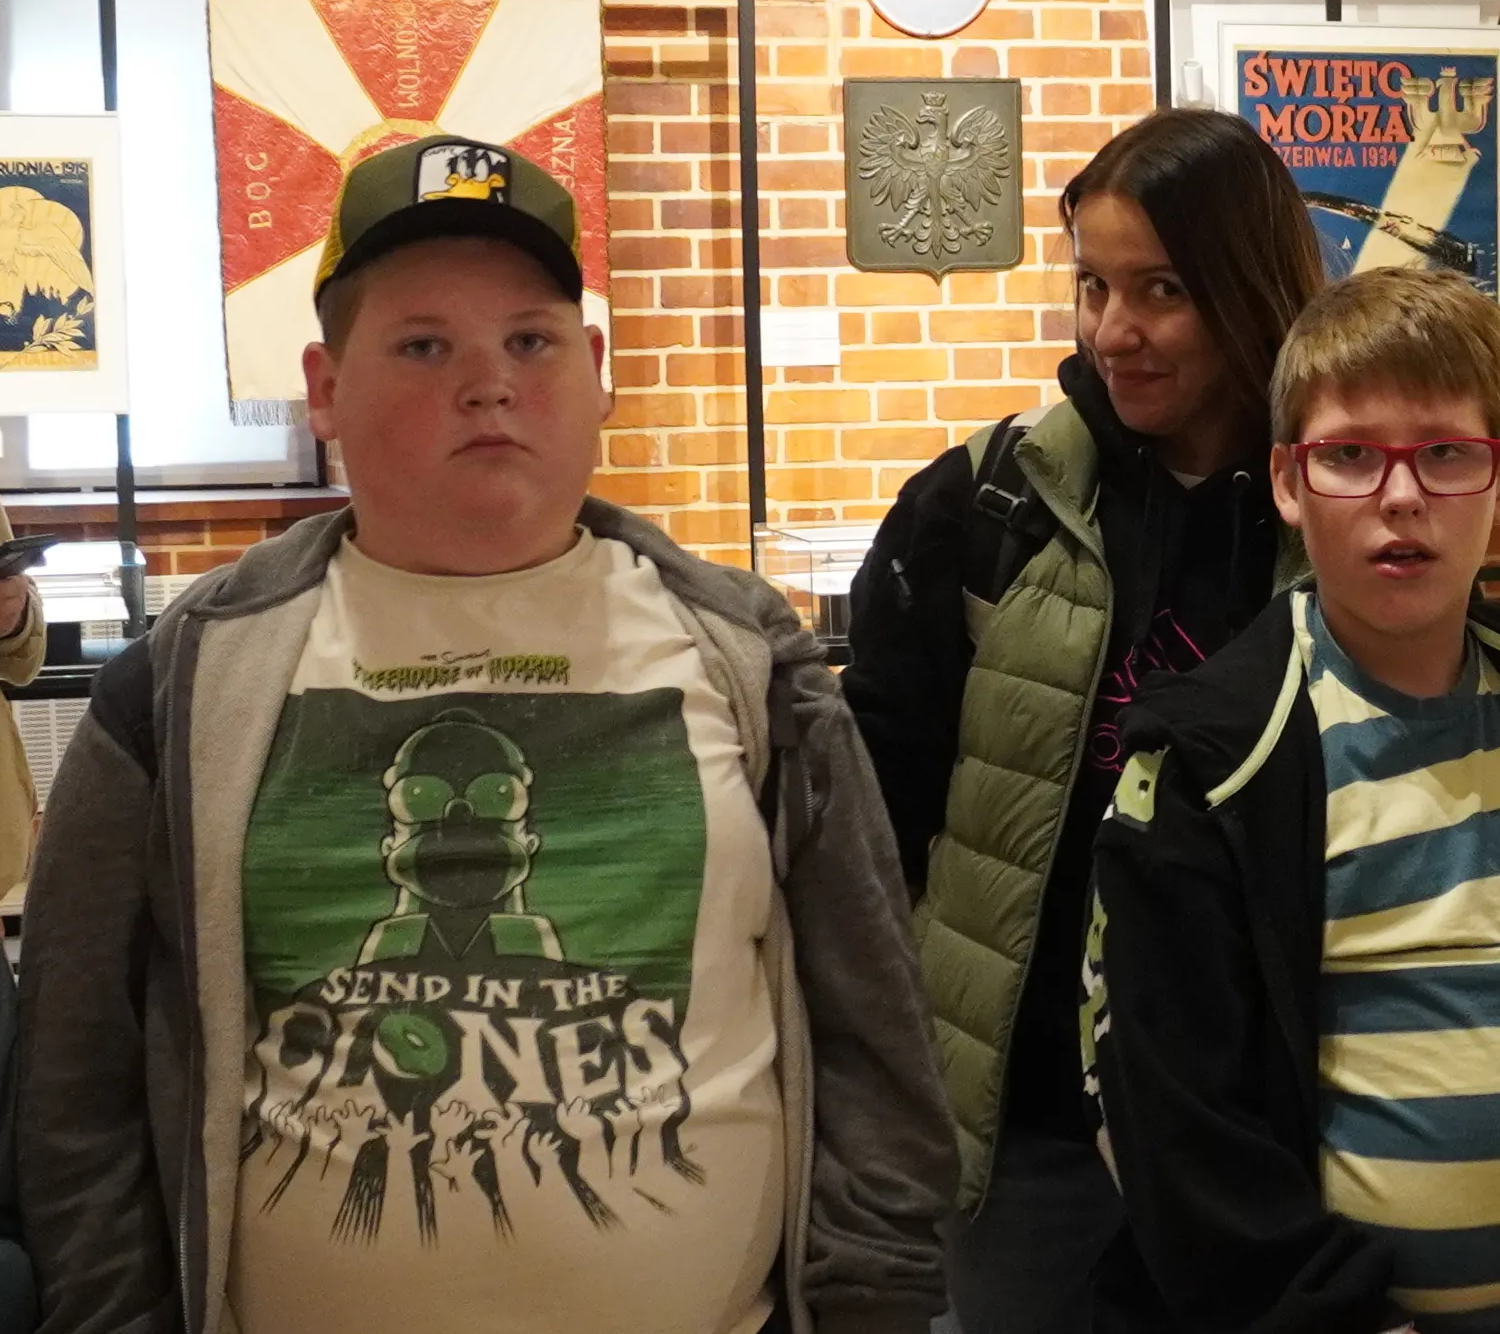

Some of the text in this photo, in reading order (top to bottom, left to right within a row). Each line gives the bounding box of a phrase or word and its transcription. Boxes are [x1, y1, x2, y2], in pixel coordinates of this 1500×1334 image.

[1244, 51, 1412, 104] ŚWIĘTO
[1255, 103, 1414, 144] MORZA
[1362, 146, 1398, 166] 1934
[487, 654, 572, 686] HORROR
[320, 967, 630, 1011] SEND IN THE
[255, 998, 688, 1116] CLONES
